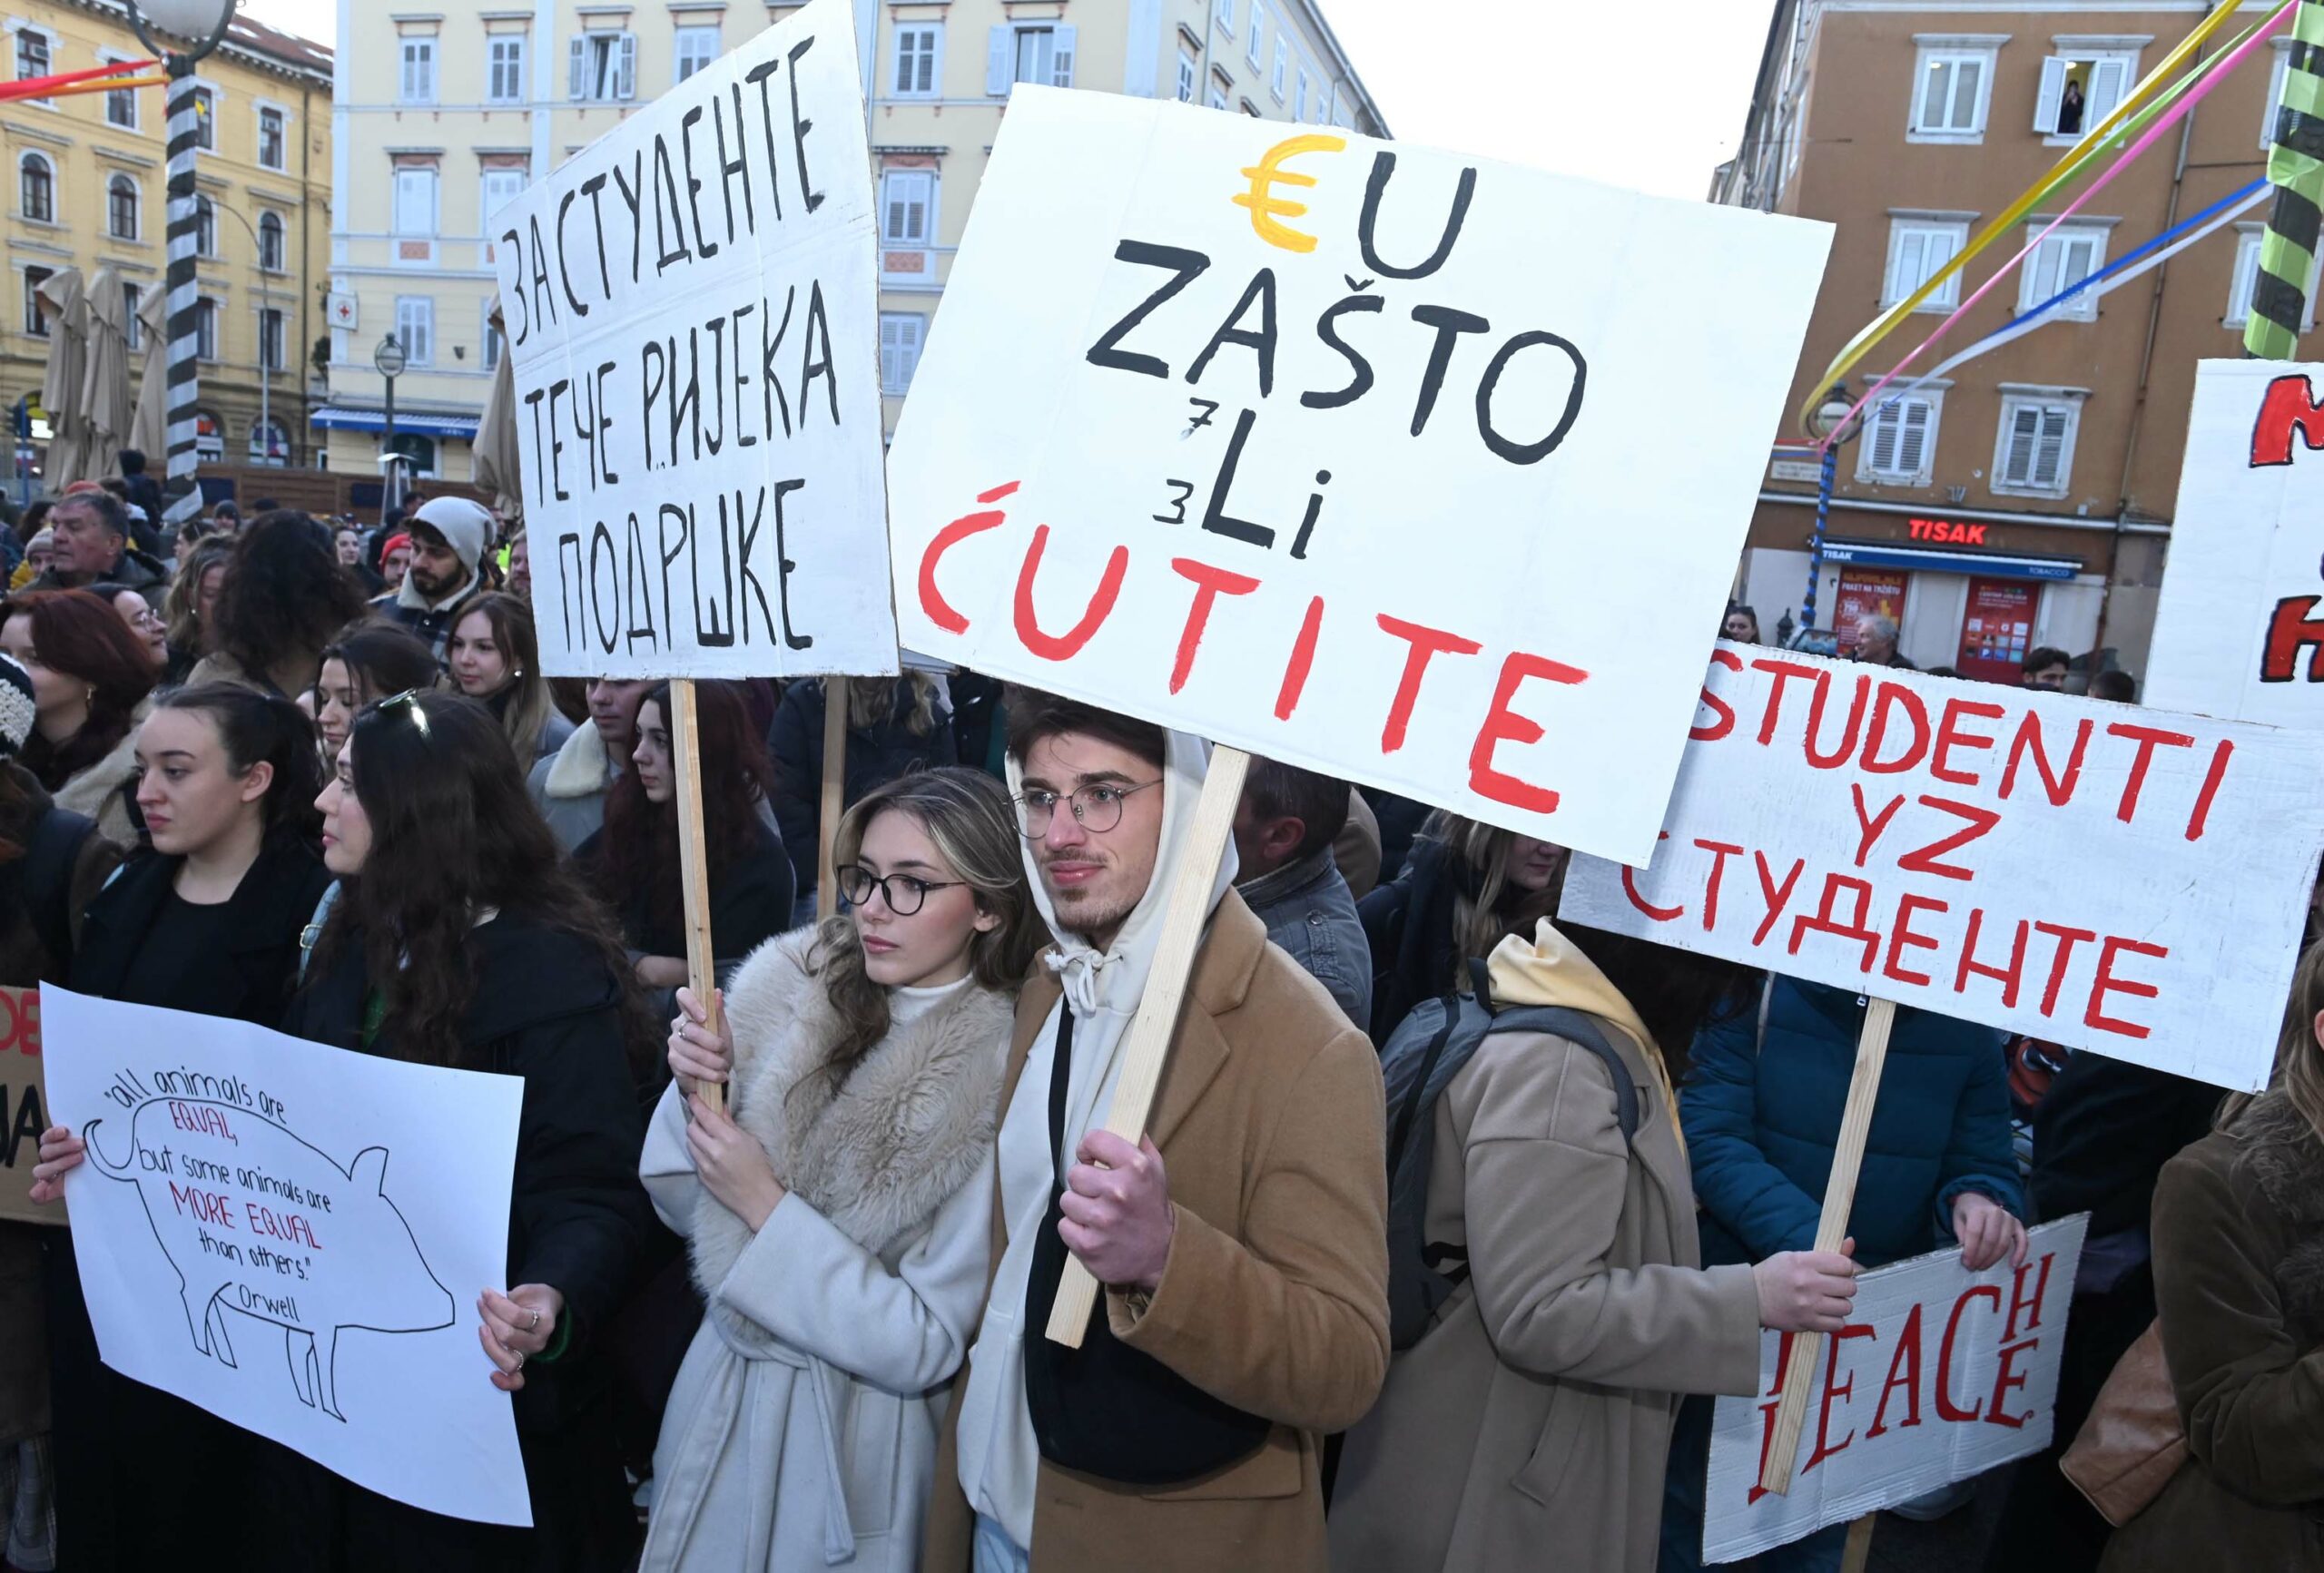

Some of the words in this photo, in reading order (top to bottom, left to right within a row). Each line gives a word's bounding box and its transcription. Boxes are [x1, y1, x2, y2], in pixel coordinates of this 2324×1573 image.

[1085, 239, 1587, 466] ZAŠTO
[526, 361, 618, 508] ТЕЧЕ
[642, 279, 841, 471] РИЈЕКА
[559, 478, 813, 655] ПОДРШКЕ
[1822, 549, 1853, 561] TISAK
[1908, 518, 1988, 545] TISAK
[2028, 565, 2070, 578] TOBACCO
[918, 480, 1590, 814] ĆUTITE
[1689, 648, 2235, 841] STUDENTI
[1621, 831, 2169, 1039] СТУДЕНТЕ
[153, 1066, 253, 1106] animals
[259, 1090, 288, 1125] are
[168, 1100, 239, 1147] EQUAL,
[135, 1137, 173, 1175] but
[182, 1154, 230, 1185] some
[237, 1165, 303, 1204] animals
[306, 1189, 332, 1214] are
[169, 1180, 236, 1229] MORE
[245, 1203, 322, 1250] EQUAL
[198, 1226, 244, 1266] than
[239, 1283, 300, 1322] Orwell
